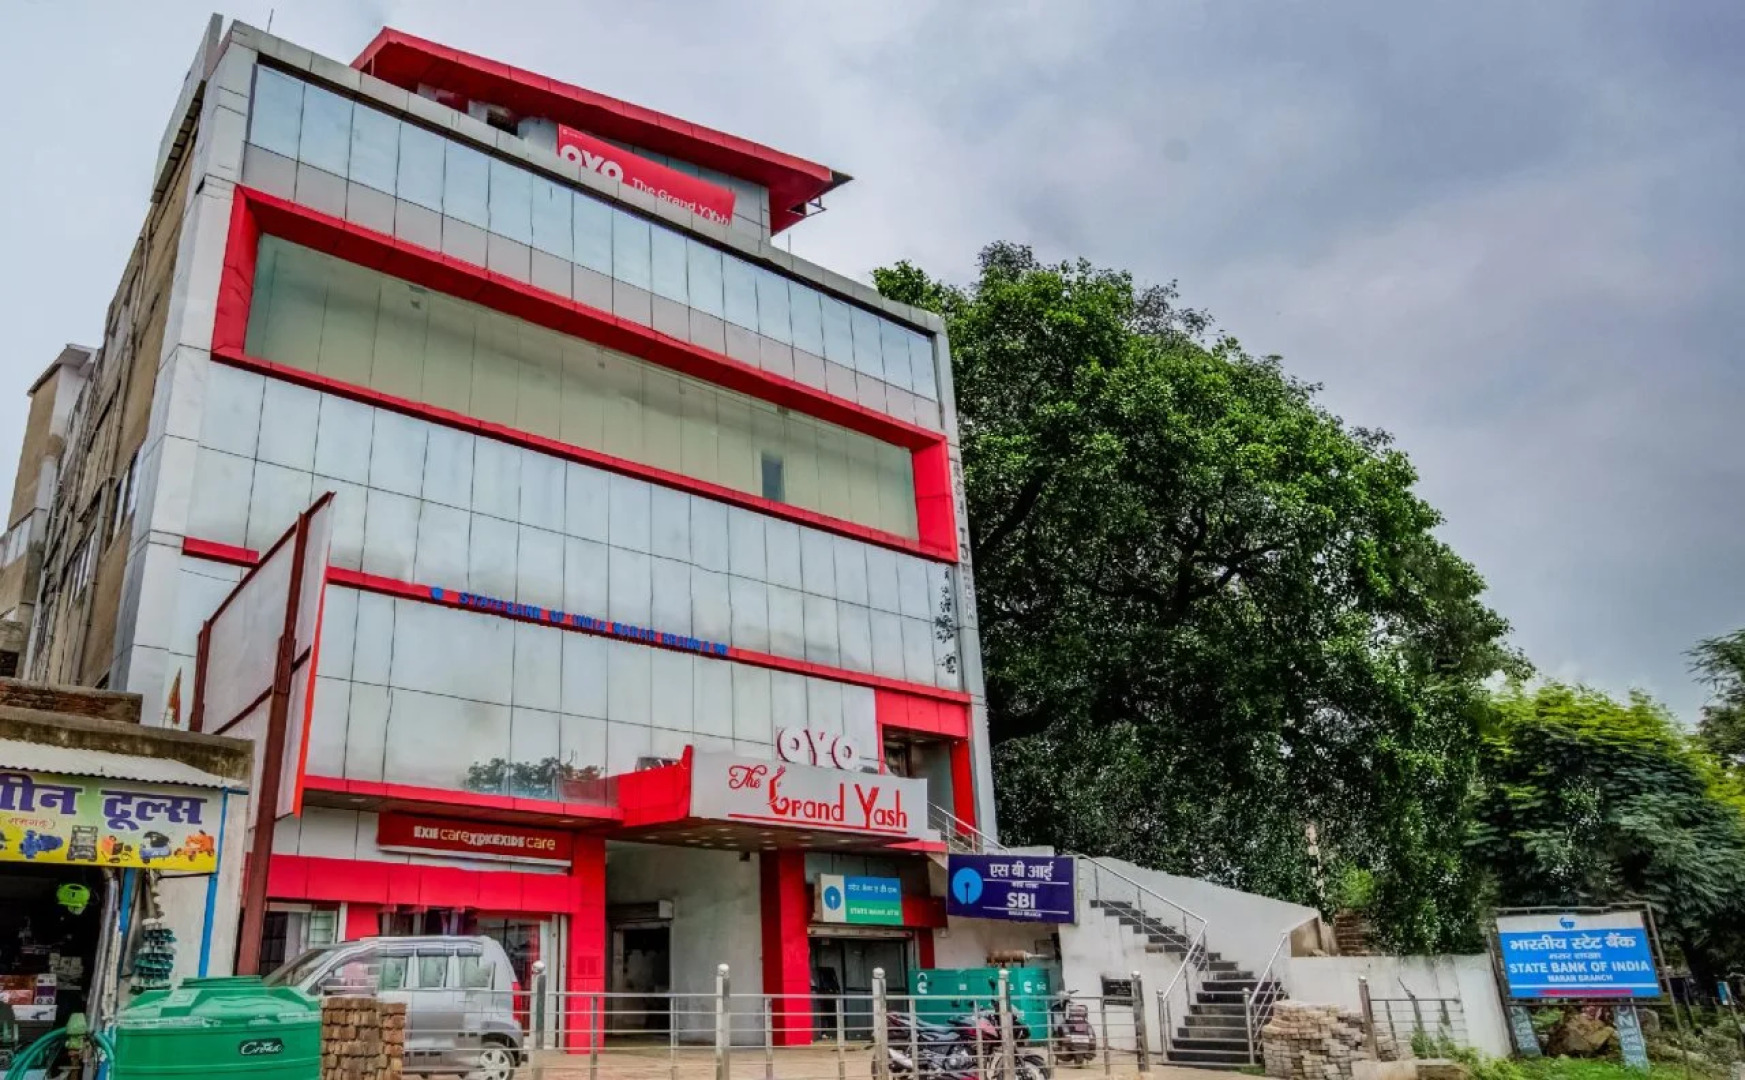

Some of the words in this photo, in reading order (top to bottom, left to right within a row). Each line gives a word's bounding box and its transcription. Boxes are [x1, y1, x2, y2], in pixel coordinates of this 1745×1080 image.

[632, 177, 655, 197] The
[658, 189, 696, 213] Grand
[776, 727, 861, 770] OYO
[728, 764, 768, 790] The
[767, 765, 845, 822] Grand
[854, 783, 908, 830] Yash
[100, 789, 208, 831] टूल्स
[526, 837, 556, 851] care
[990, 863, 1010, 878] एस
[1027, 861, 1054, 881] आई
[1007, 892, 1036, 909] SBI
[1509, 934, 1568, 951] भारतीय
[1570, 933, 1603, 950] स्टेट
[1508, 962, 1549, 974] STATE
[1550, 961, 1588, 973] BANK
[1590, 961, 1608, 973] OF
[1611, 960, 1651, 973] INDIA
